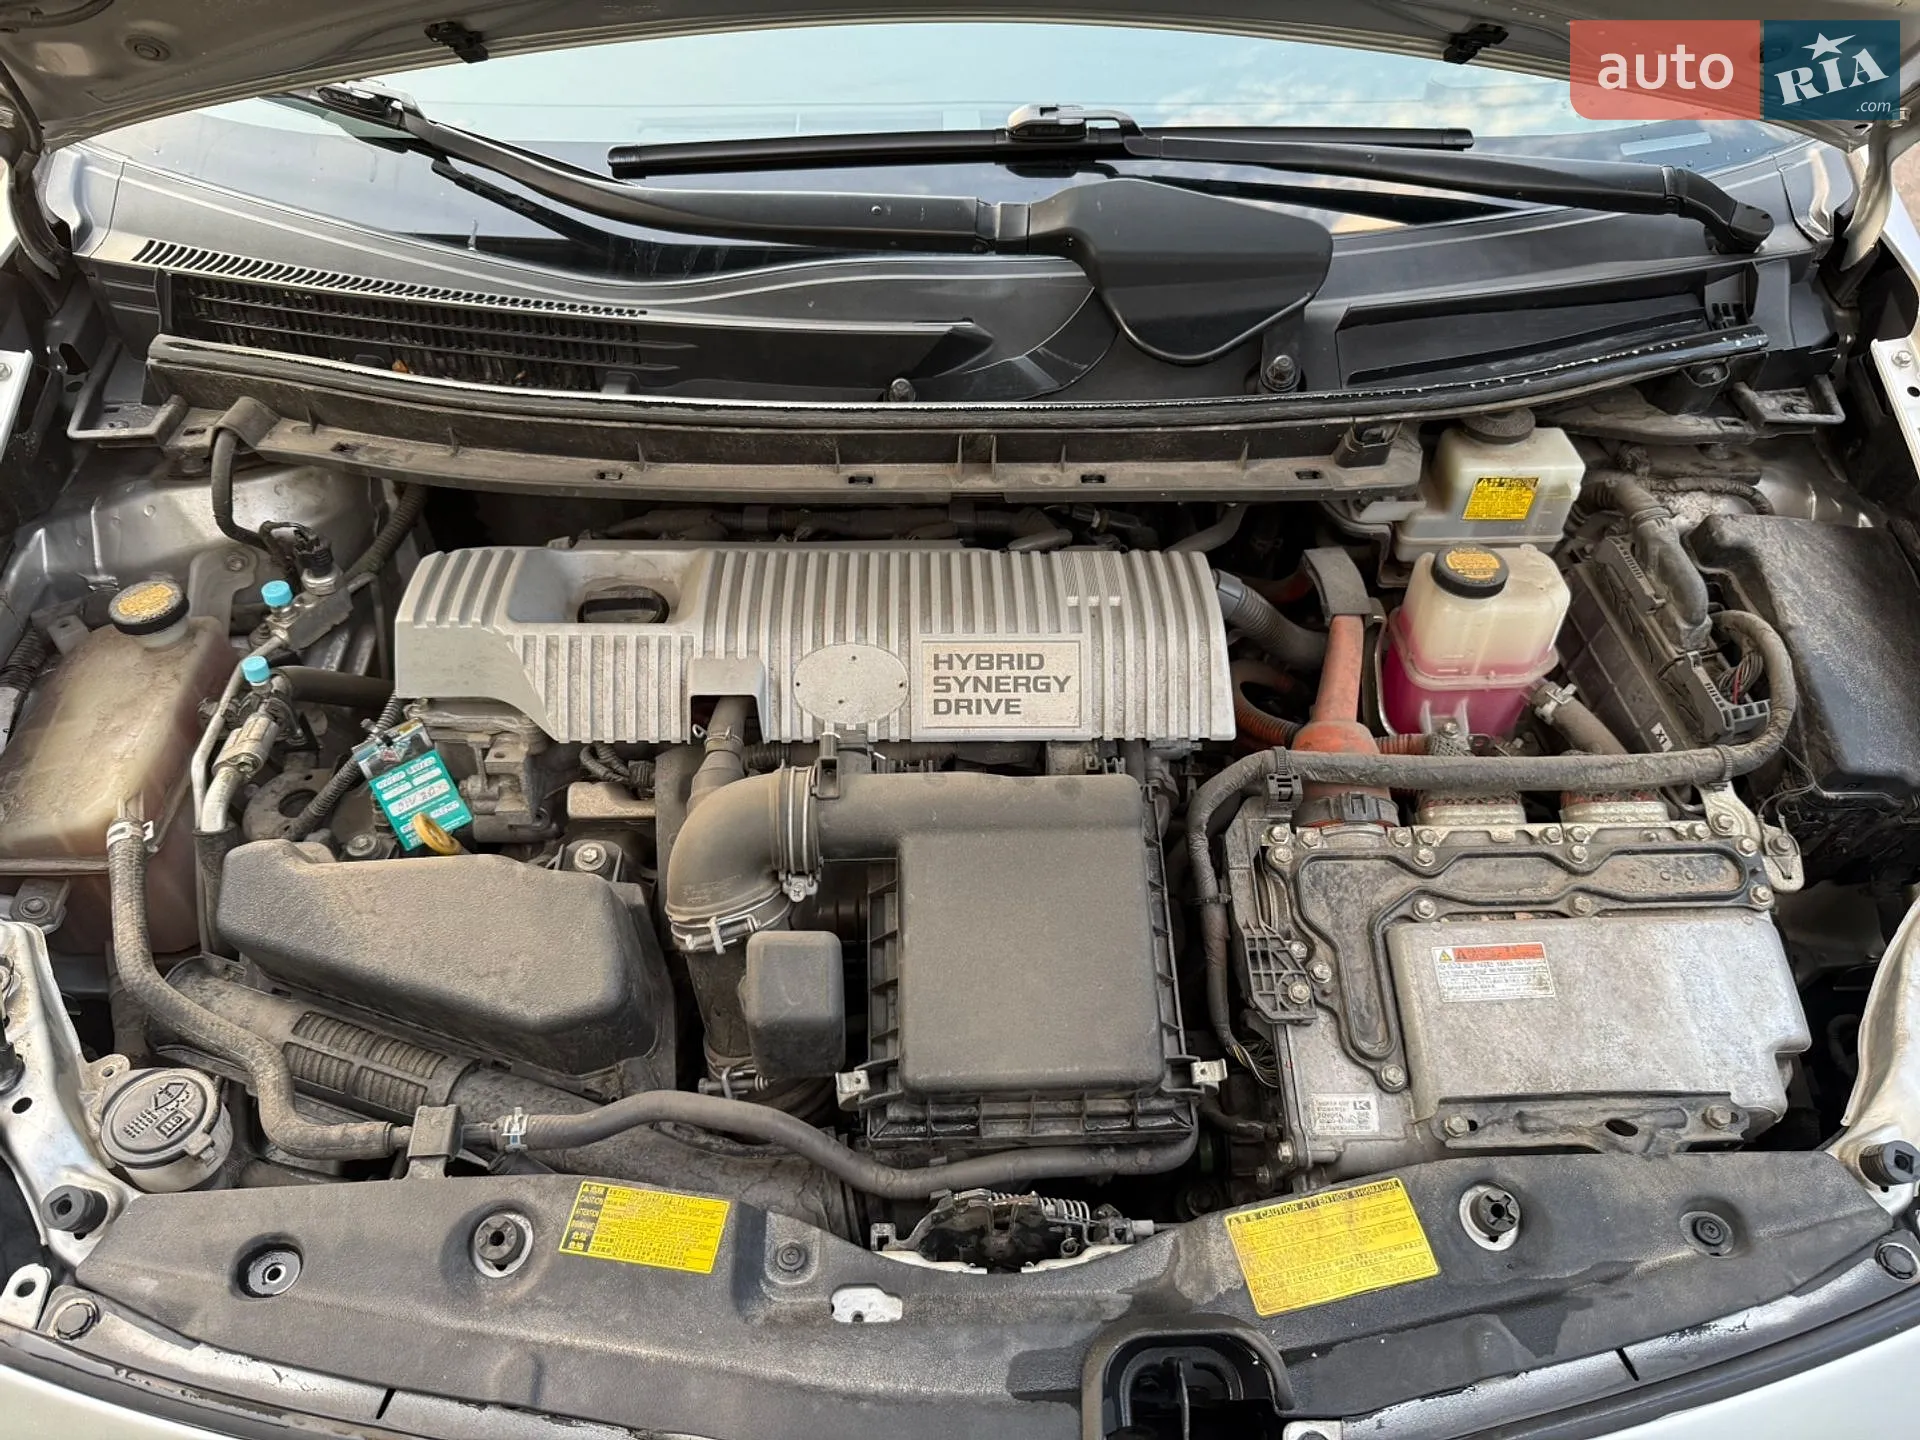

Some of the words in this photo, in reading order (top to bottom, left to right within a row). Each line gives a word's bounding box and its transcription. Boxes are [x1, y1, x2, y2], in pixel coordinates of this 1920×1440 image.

[933, 653, 1045, 670] HYBRID
[933, 675, 1072, 693] SYNERGY
[933, 698, 1022, 715] DRIVE
[1260, 1203, 1299, 1218] CAUTION
[1301, 1191, 1348, 1209] ATTENTION
